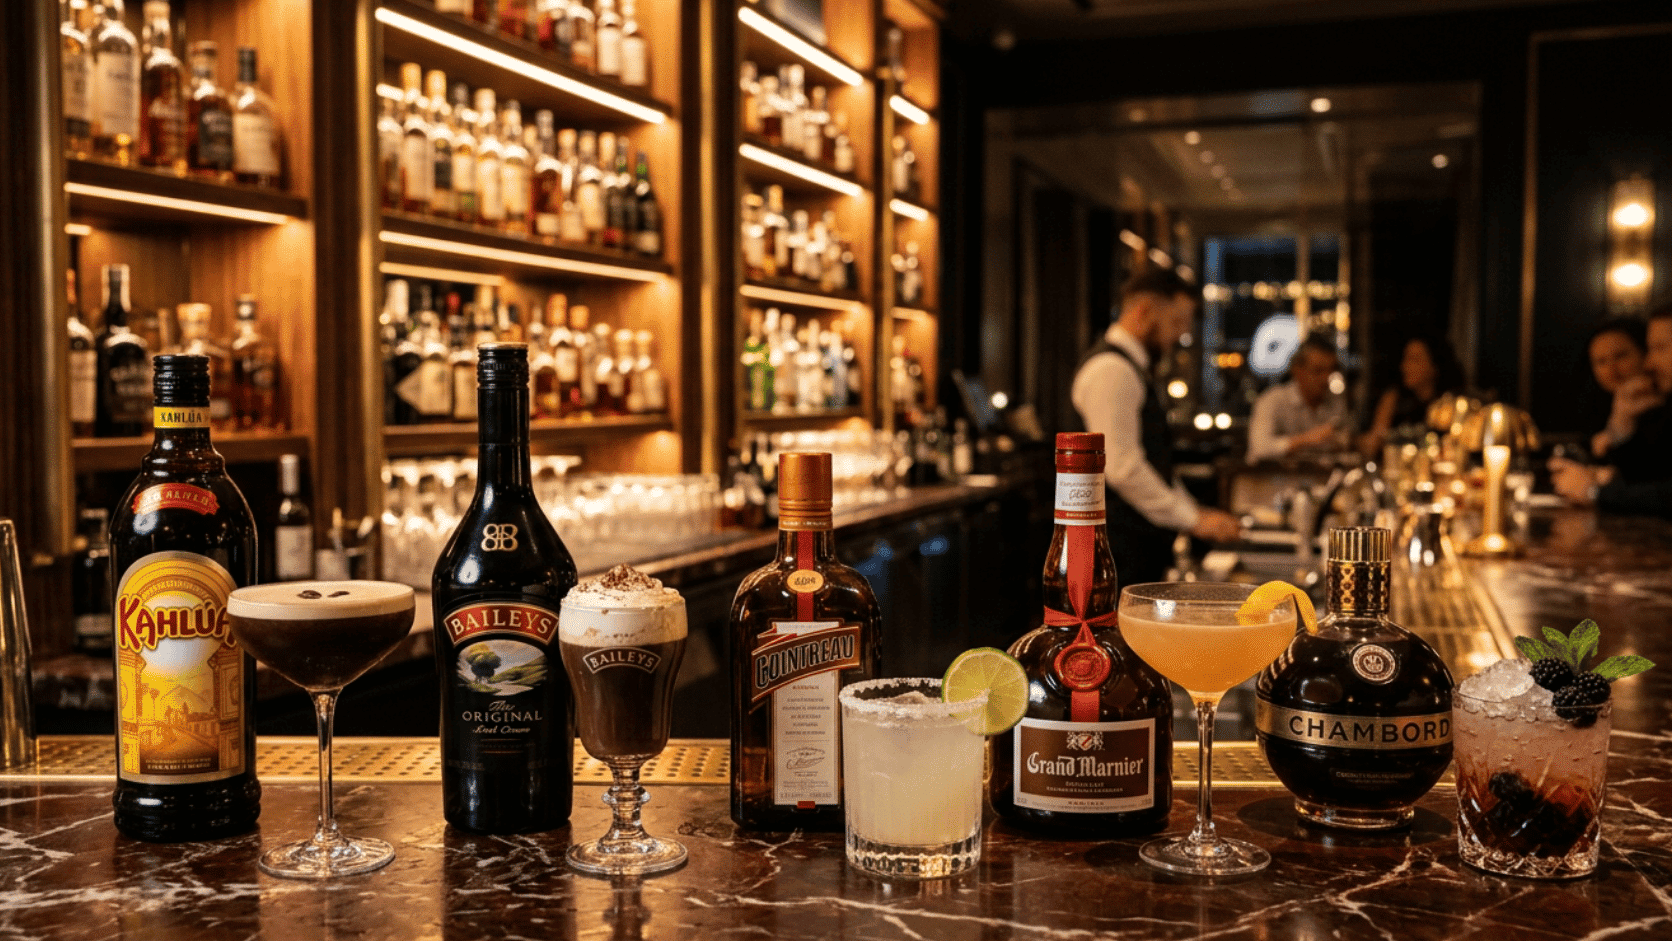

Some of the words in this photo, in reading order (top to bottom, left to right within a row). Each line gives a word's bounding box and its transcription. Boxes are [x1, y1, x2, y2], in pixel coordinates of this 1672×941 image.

[451, 609, 552, 636] BAILEYS
[589, 651, 655, 668] BAILEYS
[462, 710, 543, 722] ORIGINAL
[1289, 715, 1450, 743] CHAMBORD
[1026, 751, 1075, 776] Grand
[1076, 756, 1144, 777] Marnier
